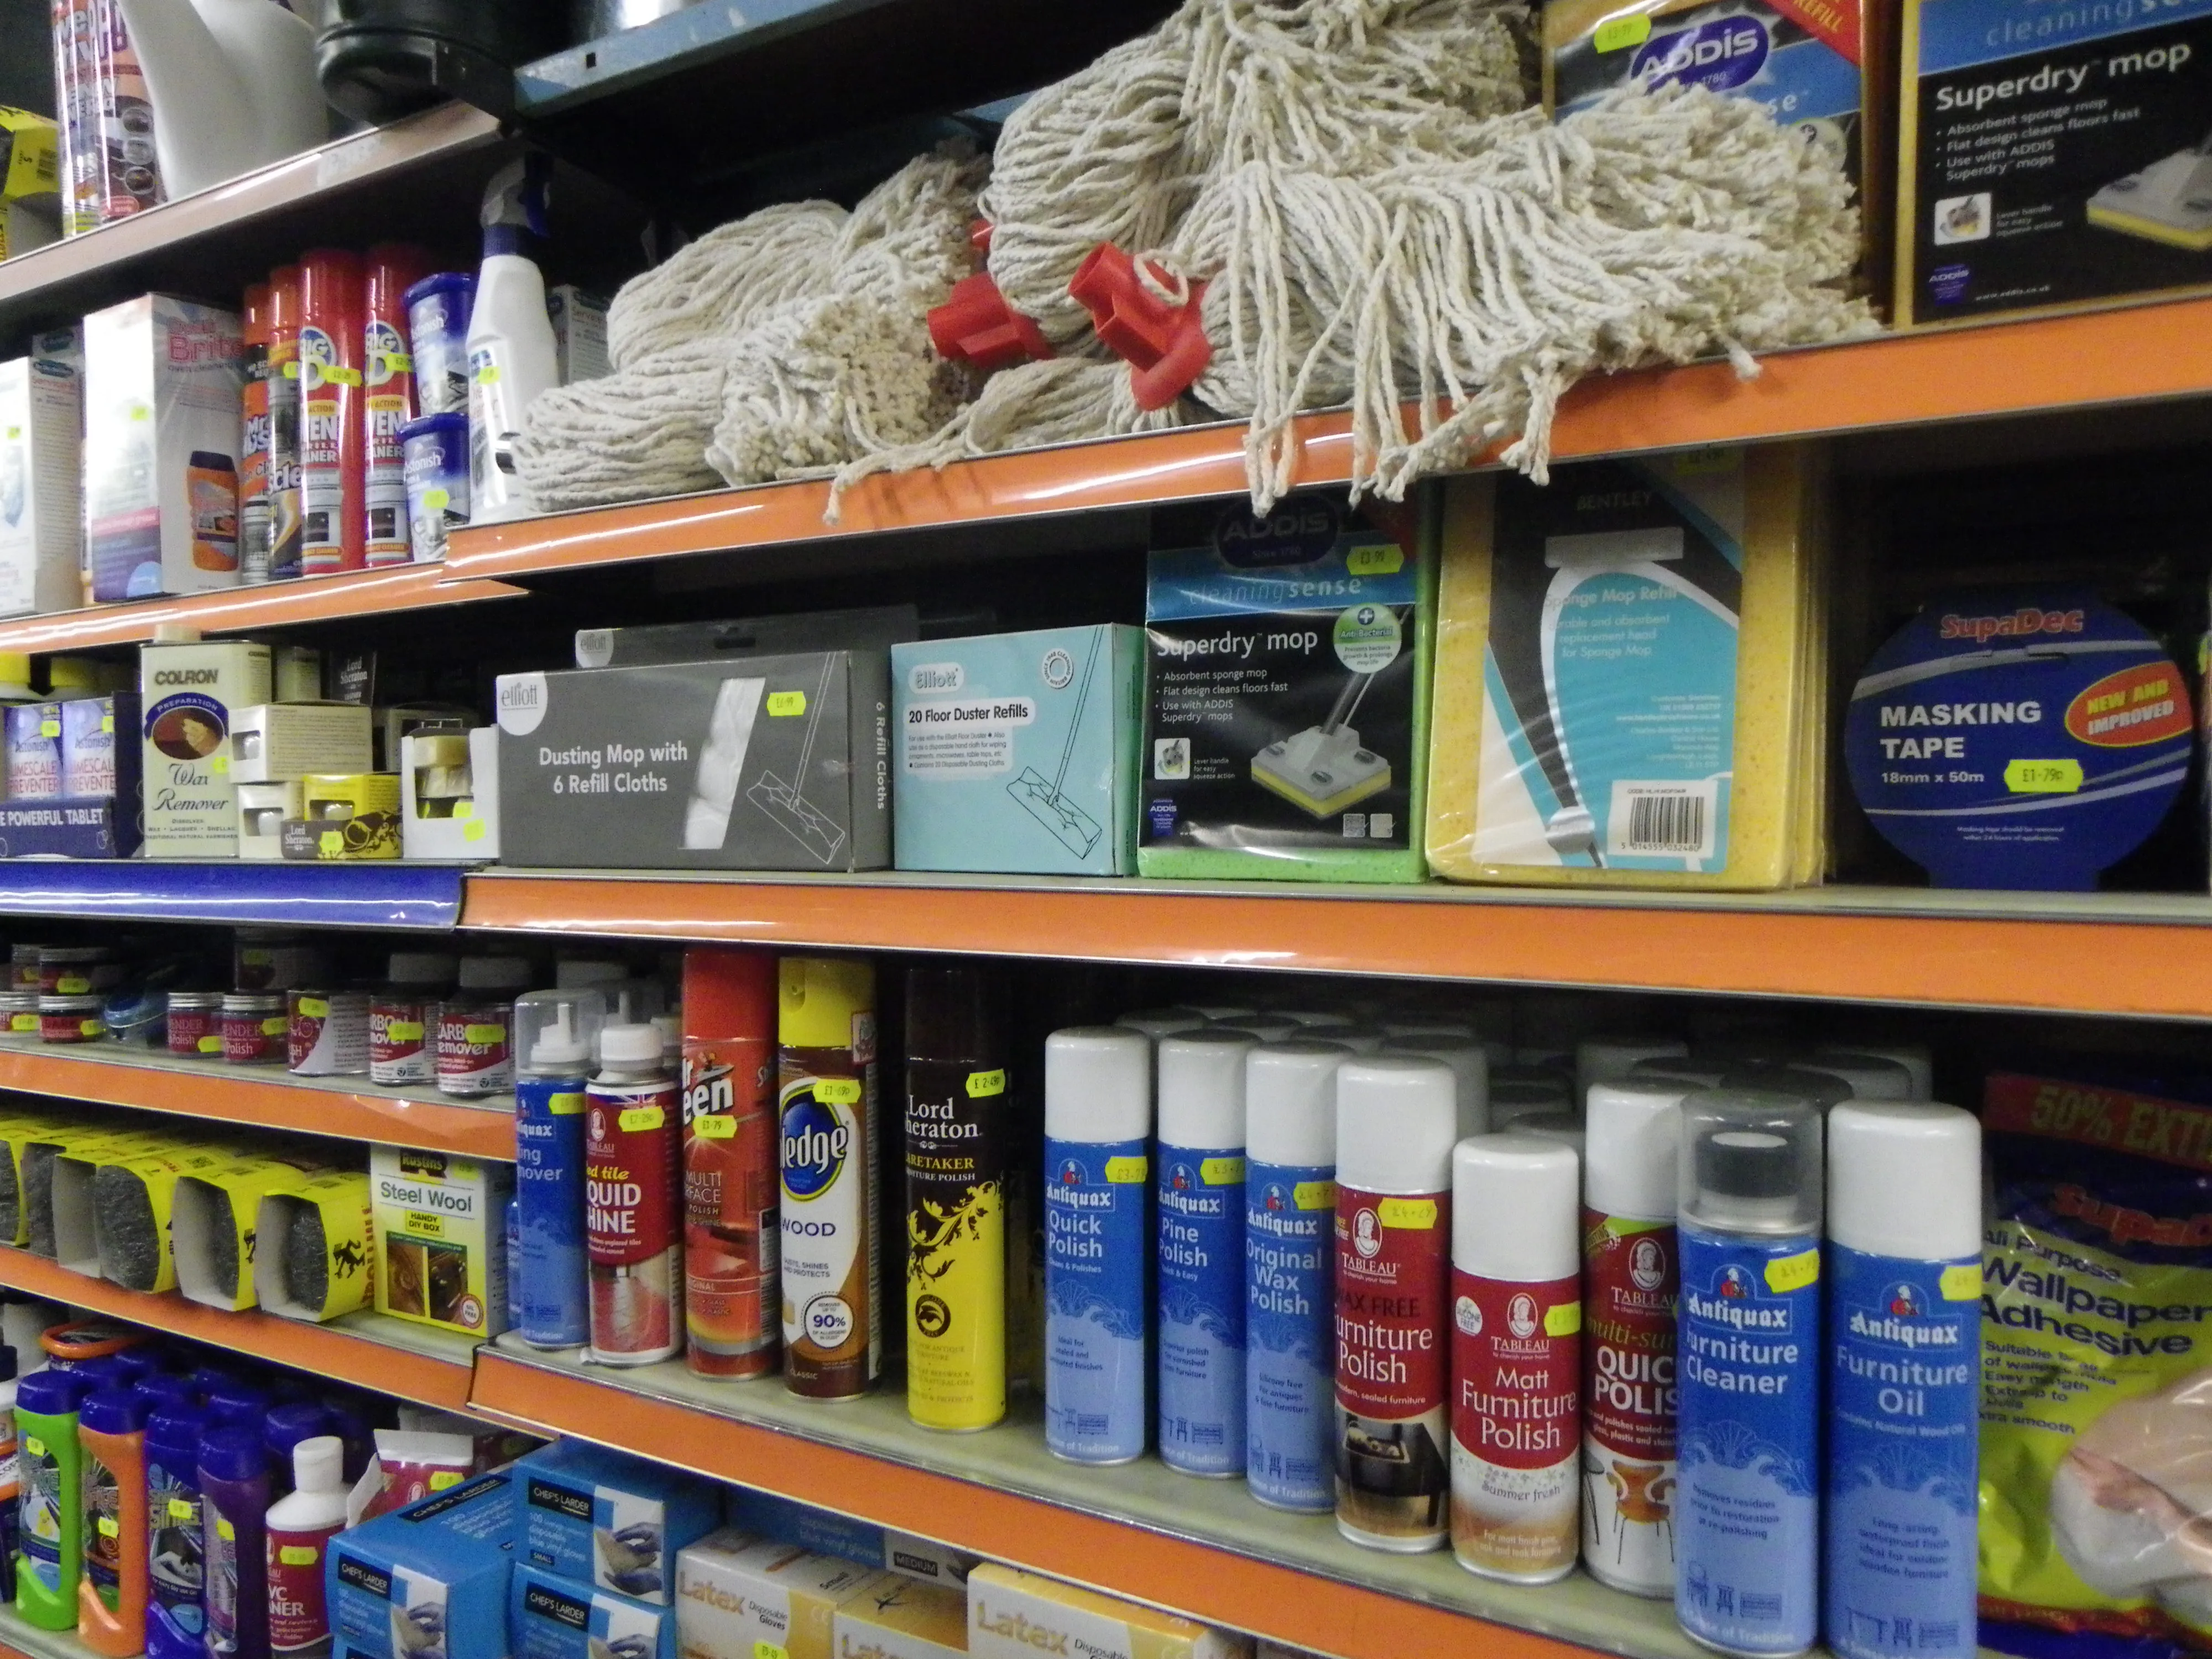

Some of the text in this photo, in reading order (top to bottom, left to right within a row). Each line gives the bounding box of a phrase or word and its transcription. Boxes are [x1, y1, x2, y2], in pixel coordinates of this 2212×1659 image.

[1936, 43, 2192, 111] Superdry mop
[1947, 98, 2109, 137] Absorbent sponge mop
[1947, 107, 2141, 153] Flat design cleans floors fast
[1947, 139, 2056, 169] Use with ADDIS
[1947, 154, 2056, 182] Superdry mops
[170, 335, 244, 363] Brite
[1603, 588, 1636, 606] Mop
[1590, 613, 1670, 627] and absorbent
[1940, 608, 2084, 643] SupaDec
[580, 632, 607, 651] elliott
[1156, 630, 1318, 662] Superdry mop
[1559, 628, 1657, 645] replacement head
[346, 656, 362, 671] Lord
[1562, 645, 1652, 659] for Sponge Mop
[155, 669, 221, 686] COLRON
[340, 669, 368, 684] Sheraton
[915, 668, 958, 689] Elliott
[1164, 669, 1267, 684] Absorbent sponge mop
[500, 681, 539, 707] elliott
[1164, 681, 1288, 698] Flat design cleans floors fast
[2086, 679, 2169, 715] NEW AND
[156, 697, 218, 713] PREPARATION
[909, 703, 1029, 724] 20 Floor Duster Refills
[1162, 699, 1234, 711] Use with ADDIS
[1881, 701, 2042, 727] MASKING
[1162, 712, 1233, 725] Superdry mops
[2088, 701, 2174, 735] IMPROVED
[539, 739, 688, 769] Dusting Mop with
[876, 701, 886, 811] 6 Refill Cloths
[1881, 737, 1965, 759] TAPE
[168, 762, 210, 786] Wax
[553, 772, 668, 794] 6 Refill Cloths
[1881, 771, 1985, 784] 18mm x 50m
[152, 788, 229, 812] Remover
[8, 808, 104, 827] POWERFUL TABLET
[285, 833, 314, 844] Sheraton
[291, 825, 306, 836] Lord
[909, 1094, 954, 1119] Lord
[2030, 1084, 2112, 1142] 50%
[602, 1165, 630, 1181] tile
[938, 1173, 975, 1182] POLISH
[380, 1181, 472, 1212] Steel Wool
[1047, 1183, 1112, 1208] Antiquax
[1159, 1188, 1220, 1214] Antiquax
[410, 1212, 438, 1223] HANDY
[688, 1203, 719, 1215] POLISH
[1248, 1206, 1318, 1237] Antiquax
[408, 1220, 441, 1233] DIY BOX
[1049, 1209, 1102, 1235] Quick
[1162, 1217, 1199, 1243] Pine
[1048, 1232, 1103, 1258] Polish
[1159, 1238, 1208, 1267] Polish
[1246, 1237, 1322, 1270] Original
[2016, 1233, 2122, 1281] Purpose
[793, 1269, 831, 1278] PROTECTS
[1072, 1264, 1102, 1274] Polishes
[1342, 1252, 1397, 1274] TABLEAU
[1182, 1271, 1198, 1282] Easy
[1254, 1263, 1300, 1291] Wax
[1250, 1284, 1310, 1315] Polish
[1982, 1255, 2212, 1329] Wallpaper
[1371, 1296, 1421, 1318] FREE
[1688, 1293, 1787, 1329] Antiquax
[813, 1314, 846, 1328] 90%
[1849, 1311, 1958, 1348] Antiquax
[1982, 1293, 2193, 1357] Adhesive
[1491, 1336, 1550, 1352] TABLEAU
[1687, 1330, 1799, 1364] Furniture
[1339, 1341, 1407, 1384] Polish
[1687, 1355, 1788, 1395] Cleaner
[1837, 1345, 1969, 1385] Furniture
[1495, 1365, 1550, 1390] Matt
[1361, 1390, 1426, 1405] sealed furniture
[1462, 1378, 1577, 1418] Furniture
[1879, 1388, 1924, 1417] Oil
[1481, 1416, 1561, 1451] Polish
[1604, 1417, 1634, 1432] polishes
[533, 1486, 589, 1512] CHEF'S LARDER
[895, 1555, 936, 1575] MEDIUM
[363, 1572, 388, 1589] LARDER
[680, 1571, 745, 1615] Latex
[529, 1592, 586, 1621] CHEF'S LARDER
[749, 1600, 789, 1622] Disposable
[758, 1613, 786, 1631] Gloves
[977, 1601, 1068, 1656] Latex
